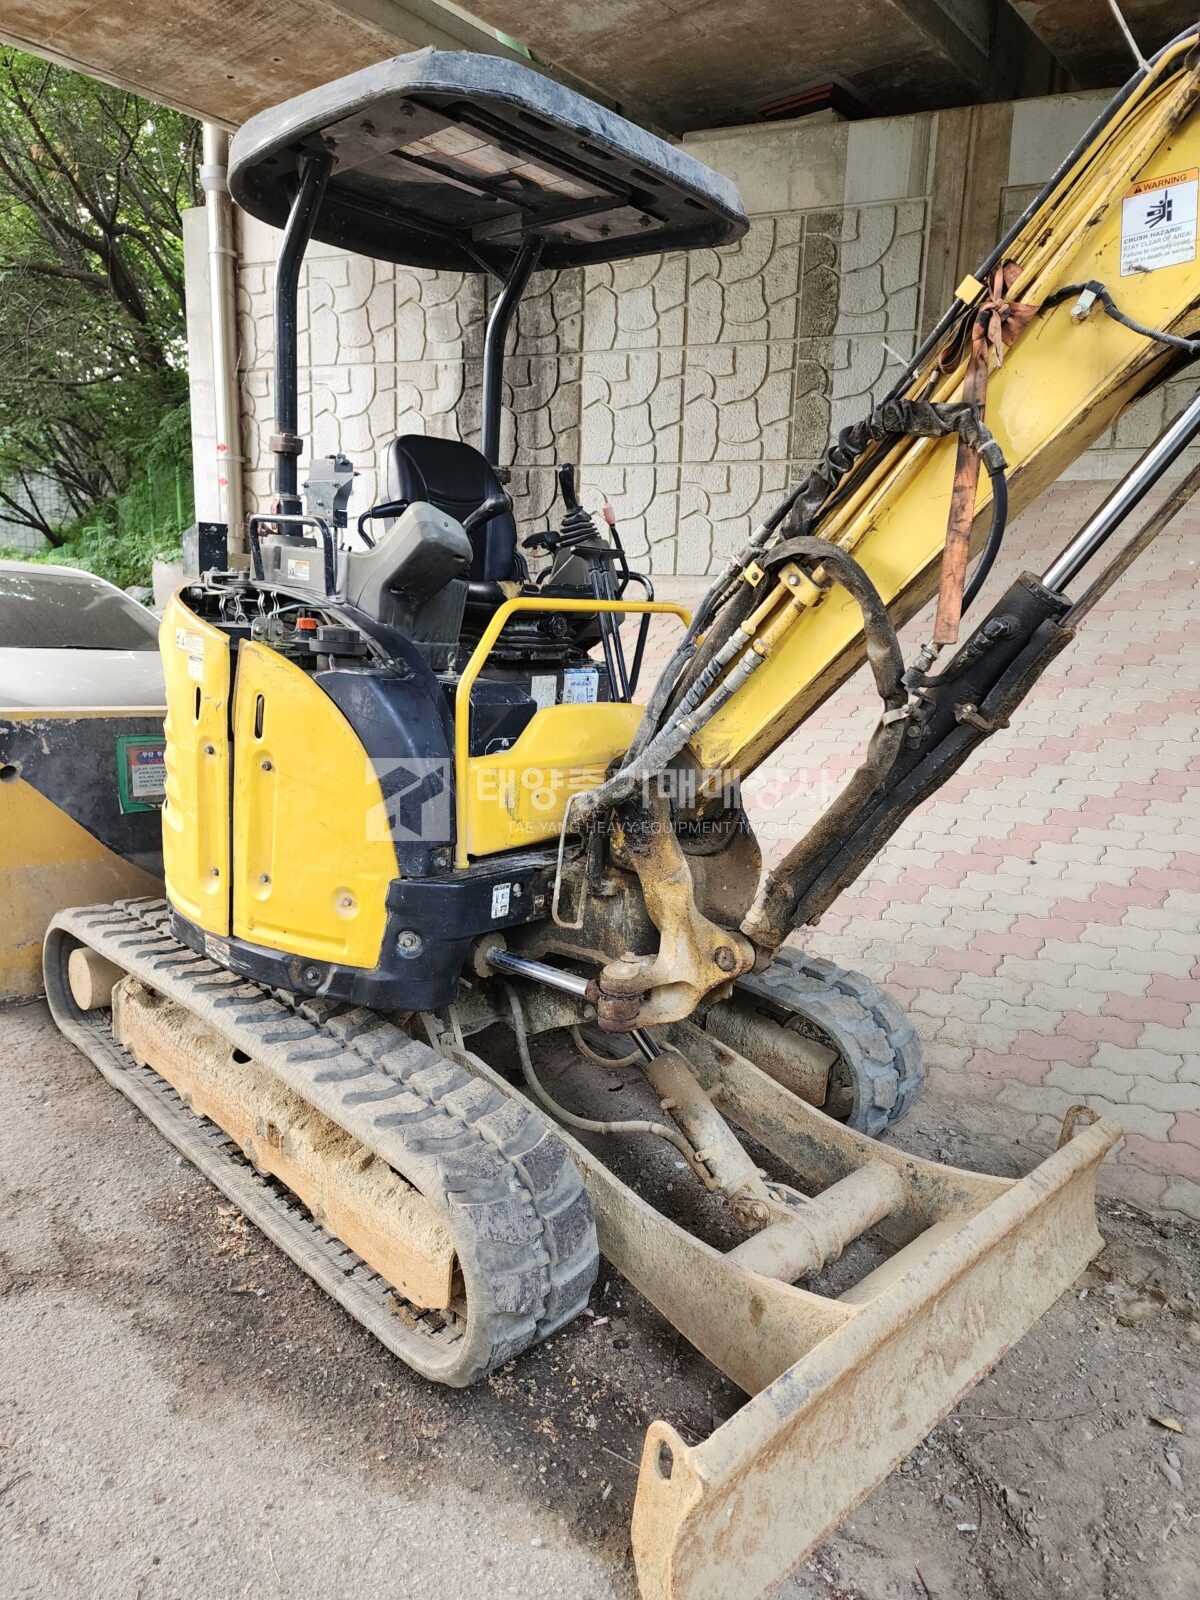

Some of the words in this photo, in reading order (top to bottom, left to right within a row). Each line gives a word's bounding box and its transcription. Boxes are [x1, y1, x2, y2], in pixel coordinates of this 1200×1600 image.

[1144, 173, 1187, 191] WARNING
[1124, 234, 1148, 244] CRUSH
[1140, 238, 1161, 247] CLEAR
